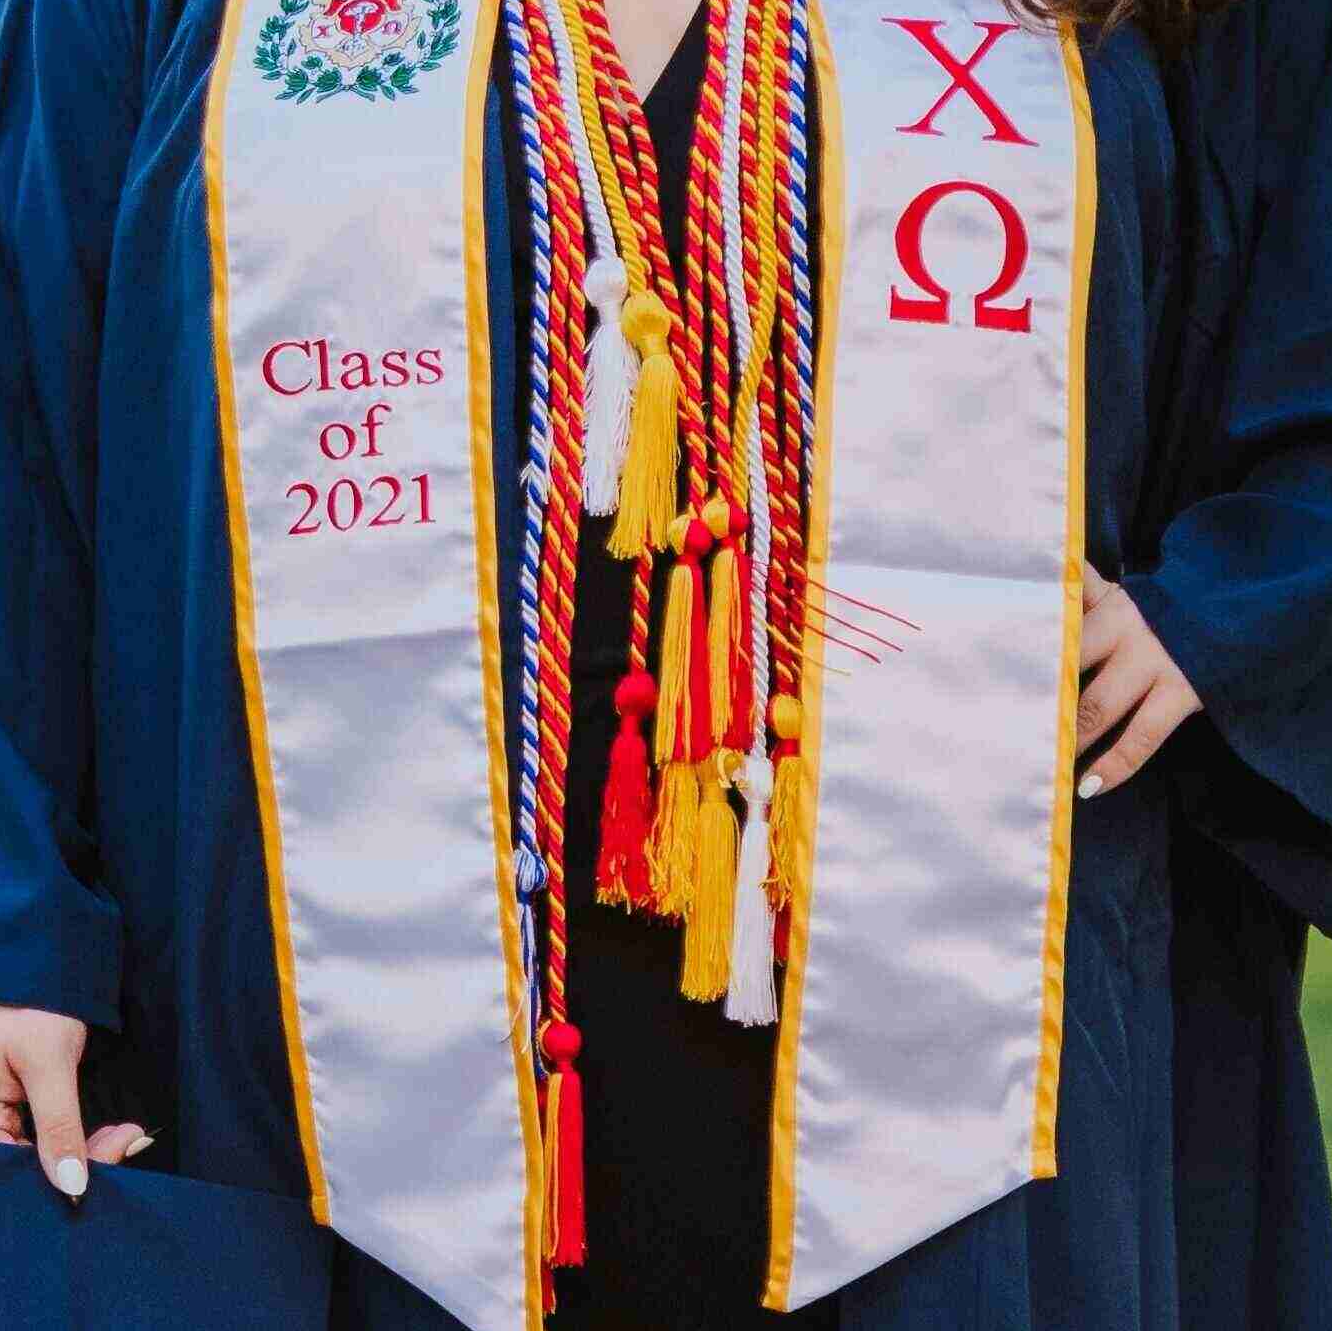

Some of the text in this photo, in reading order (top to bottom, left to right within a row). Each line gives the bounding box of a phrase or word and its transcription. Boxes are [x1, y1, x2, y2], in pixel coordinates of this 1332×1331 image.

[889, 180, 1032, 334] Ω
[262, 338, 444, 396] Class
[318, 403, 392, 459] of
[285, 473, 437, 536] 2021
